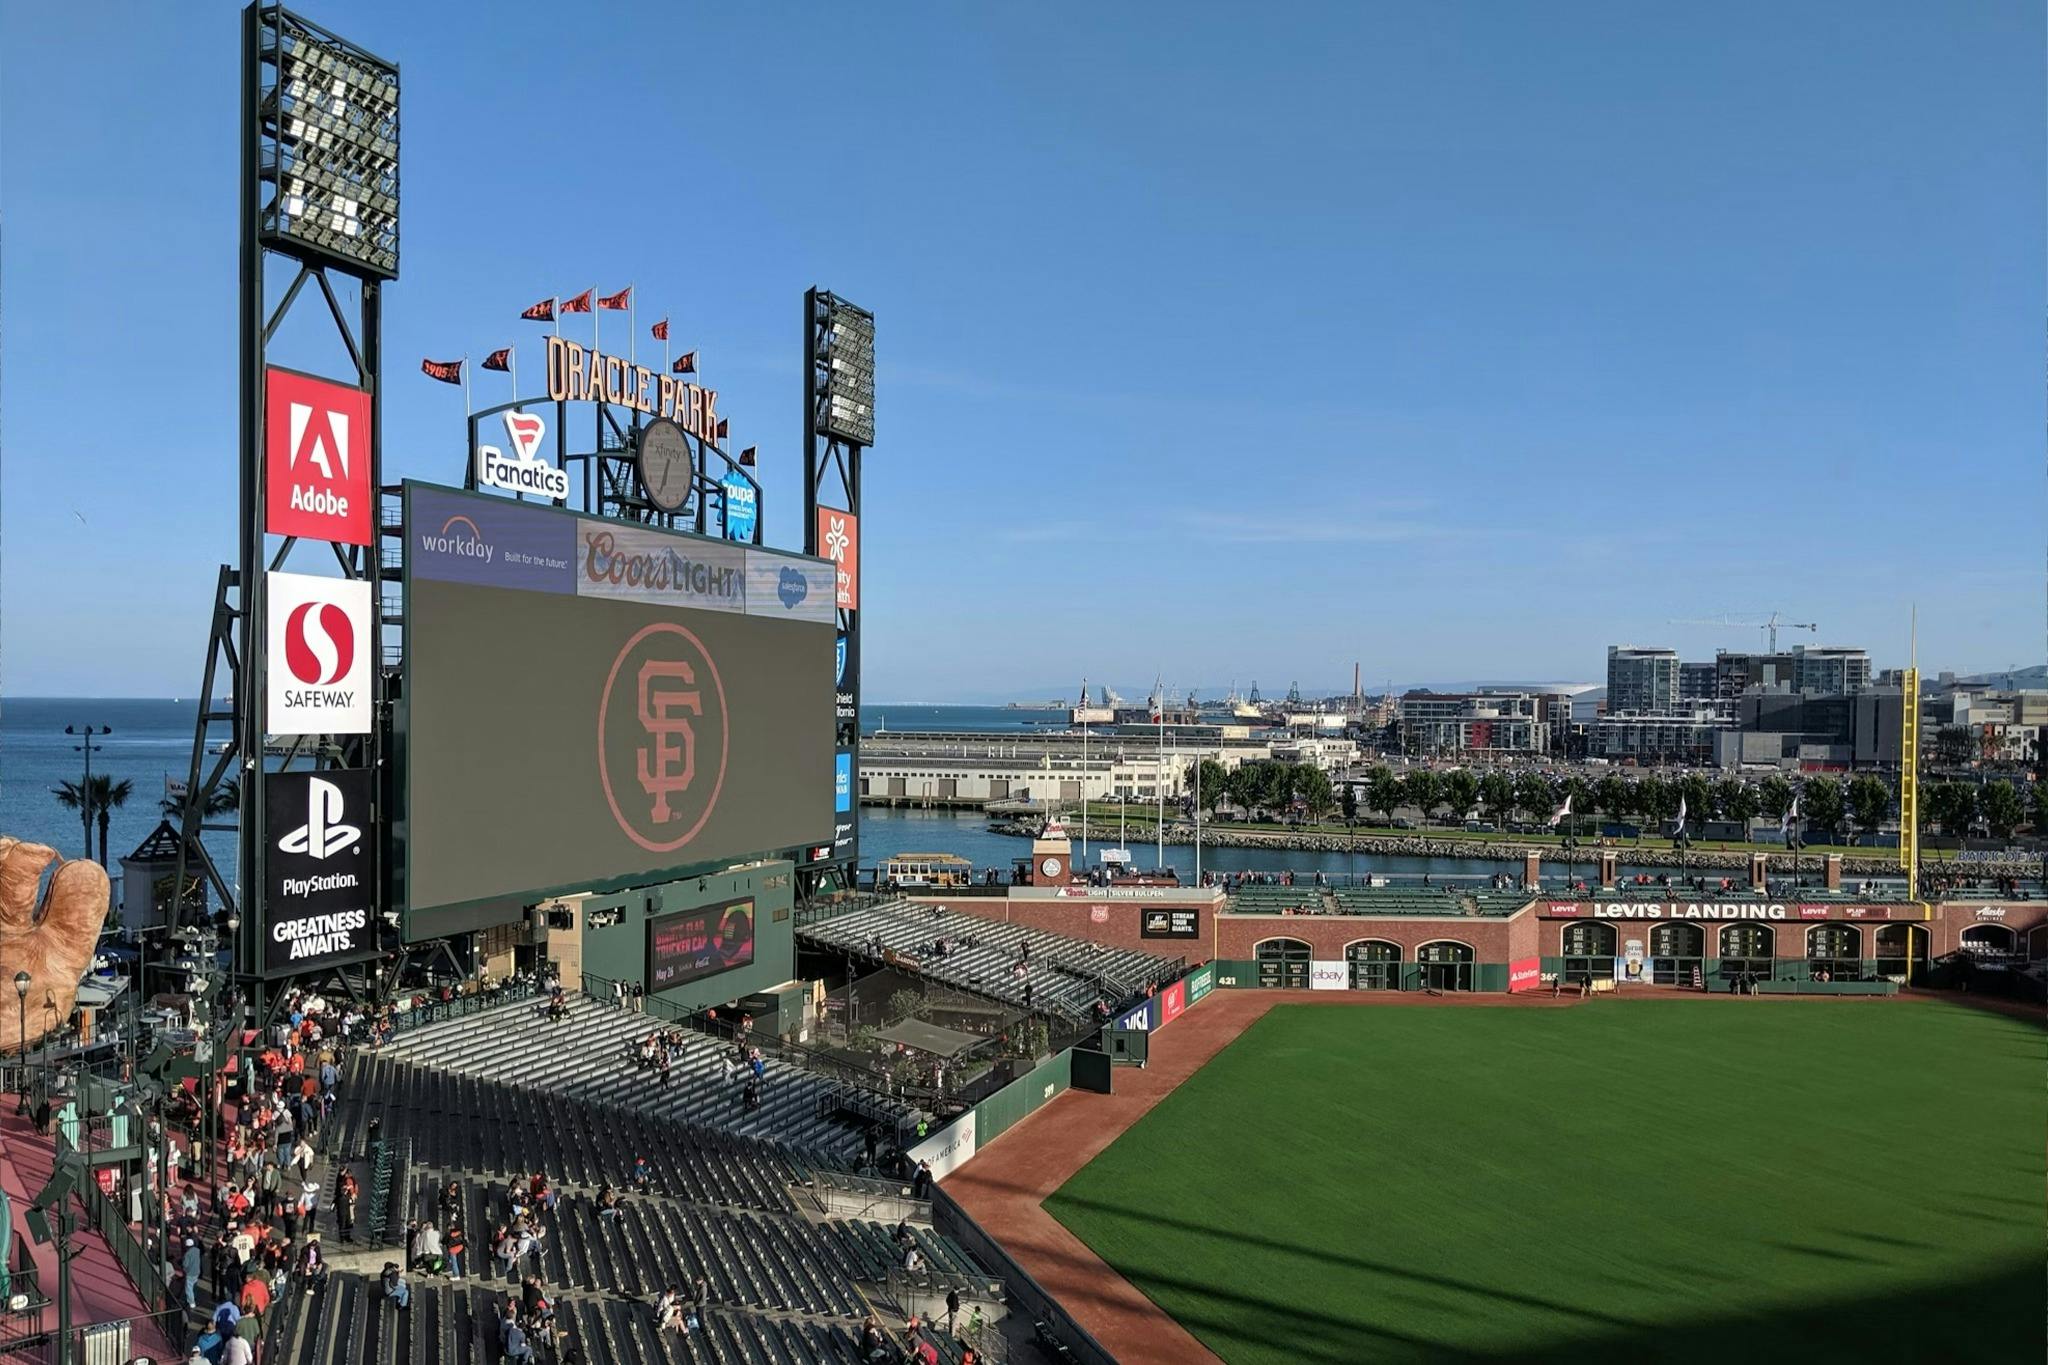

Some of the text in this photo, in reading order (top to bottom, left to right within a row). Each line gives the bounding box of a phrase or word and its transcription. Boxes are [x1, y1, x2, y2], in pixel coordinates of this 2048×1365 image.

[547, 335, 719, 449] ORACLE PARK
[485, 451, 565, 493] Fanatics
[290, 484, 349, 517] Adobe
[423, 535, 494, 563] workday
[504, 552, 521, 563] Built
[522, 554, 532, 564] for
[533, 555, 545, 566] the
[586, 531, 735, 597] Coors LIGHT
[781, 582, 805, 593] salesforce
[284, 690, 354, 708] SAFEWAY
[1959, 850, 1999, 861] BANK
[2006, 850, 2026, 861] OF
[1088, 889, 1107, 897] LIGHT
[1670, 904, 1786, 919] LANDING
[1975, 906, 2006, 917] Alaska
[273, 909, 366, 943] GREATNESS
[289, 931, 350, 960] AWAITS
[655, 968, 667, 981] May
[1218, 977, 1236, 985] 421
[1312, 969, 1344, 983] ebay
[935, 1140, 961, 1164] AMERICA
